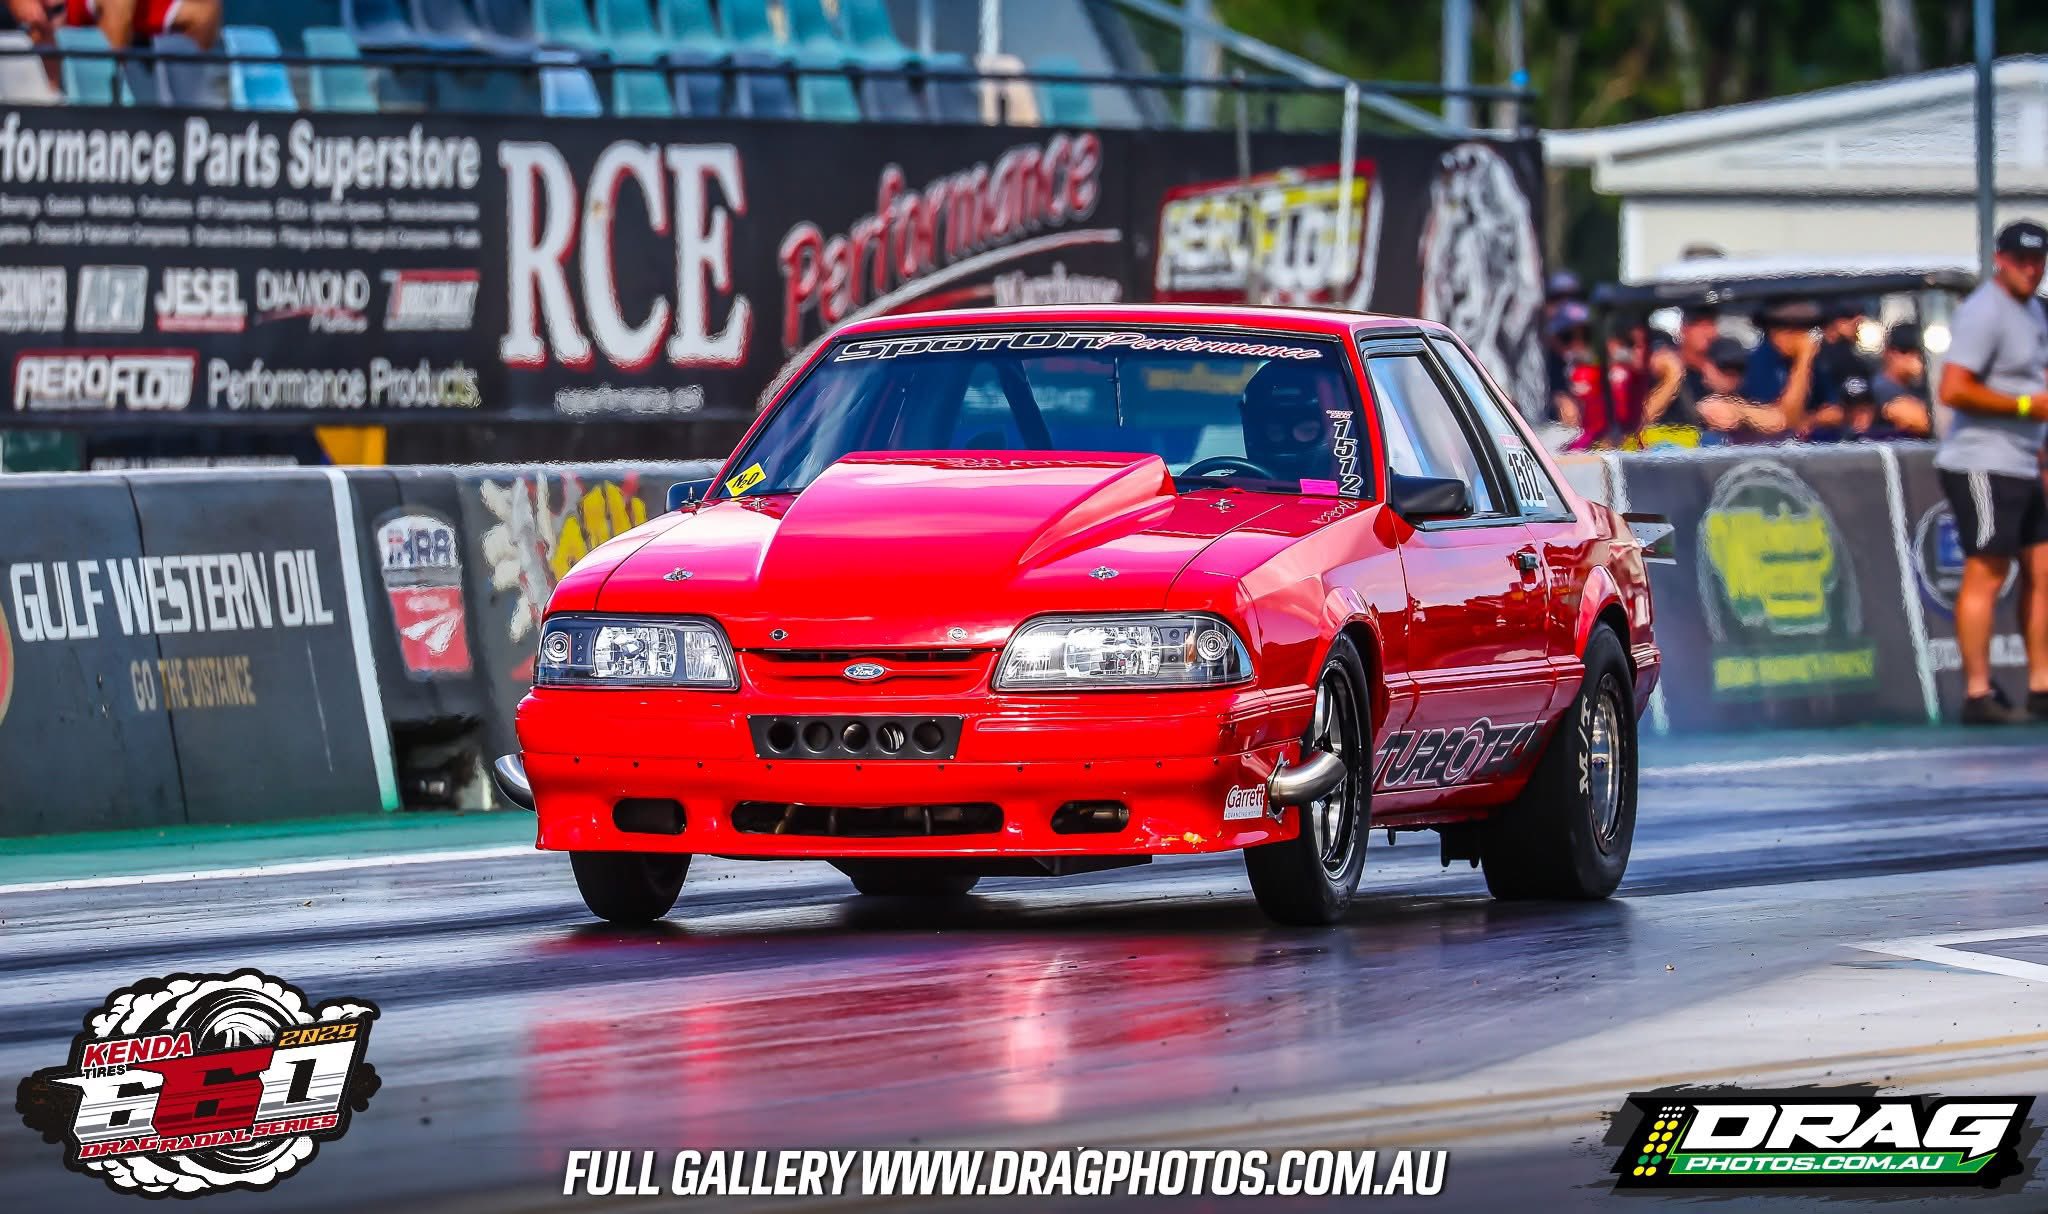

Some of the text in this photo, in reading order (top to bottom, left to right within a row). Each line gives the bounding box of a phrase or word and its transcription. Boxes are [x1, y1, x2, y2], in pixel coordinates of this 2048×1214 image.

[0, 112, 480, 200] formance Parts Superstore
[499, 140, 752, 371] RCE
[779, 131, 1101, 350] Performance
[154, 267, 247, 316] JESEL
[256, 268, 370, 311] DIAMOND
[1096, 332, 1323, 360] Performance
[15, 355, 481, 410] AEROFLOW Performance Products
[1333, 420, 1364, 497] 1512
[1508, 453, 1545, 501] 1512
[10, 549, 334, 642] GULF WESTERN OIL
[130, 655, 257, 711] GO THE DISTANCE
[1227, 784, 1266, 808] Garrett
